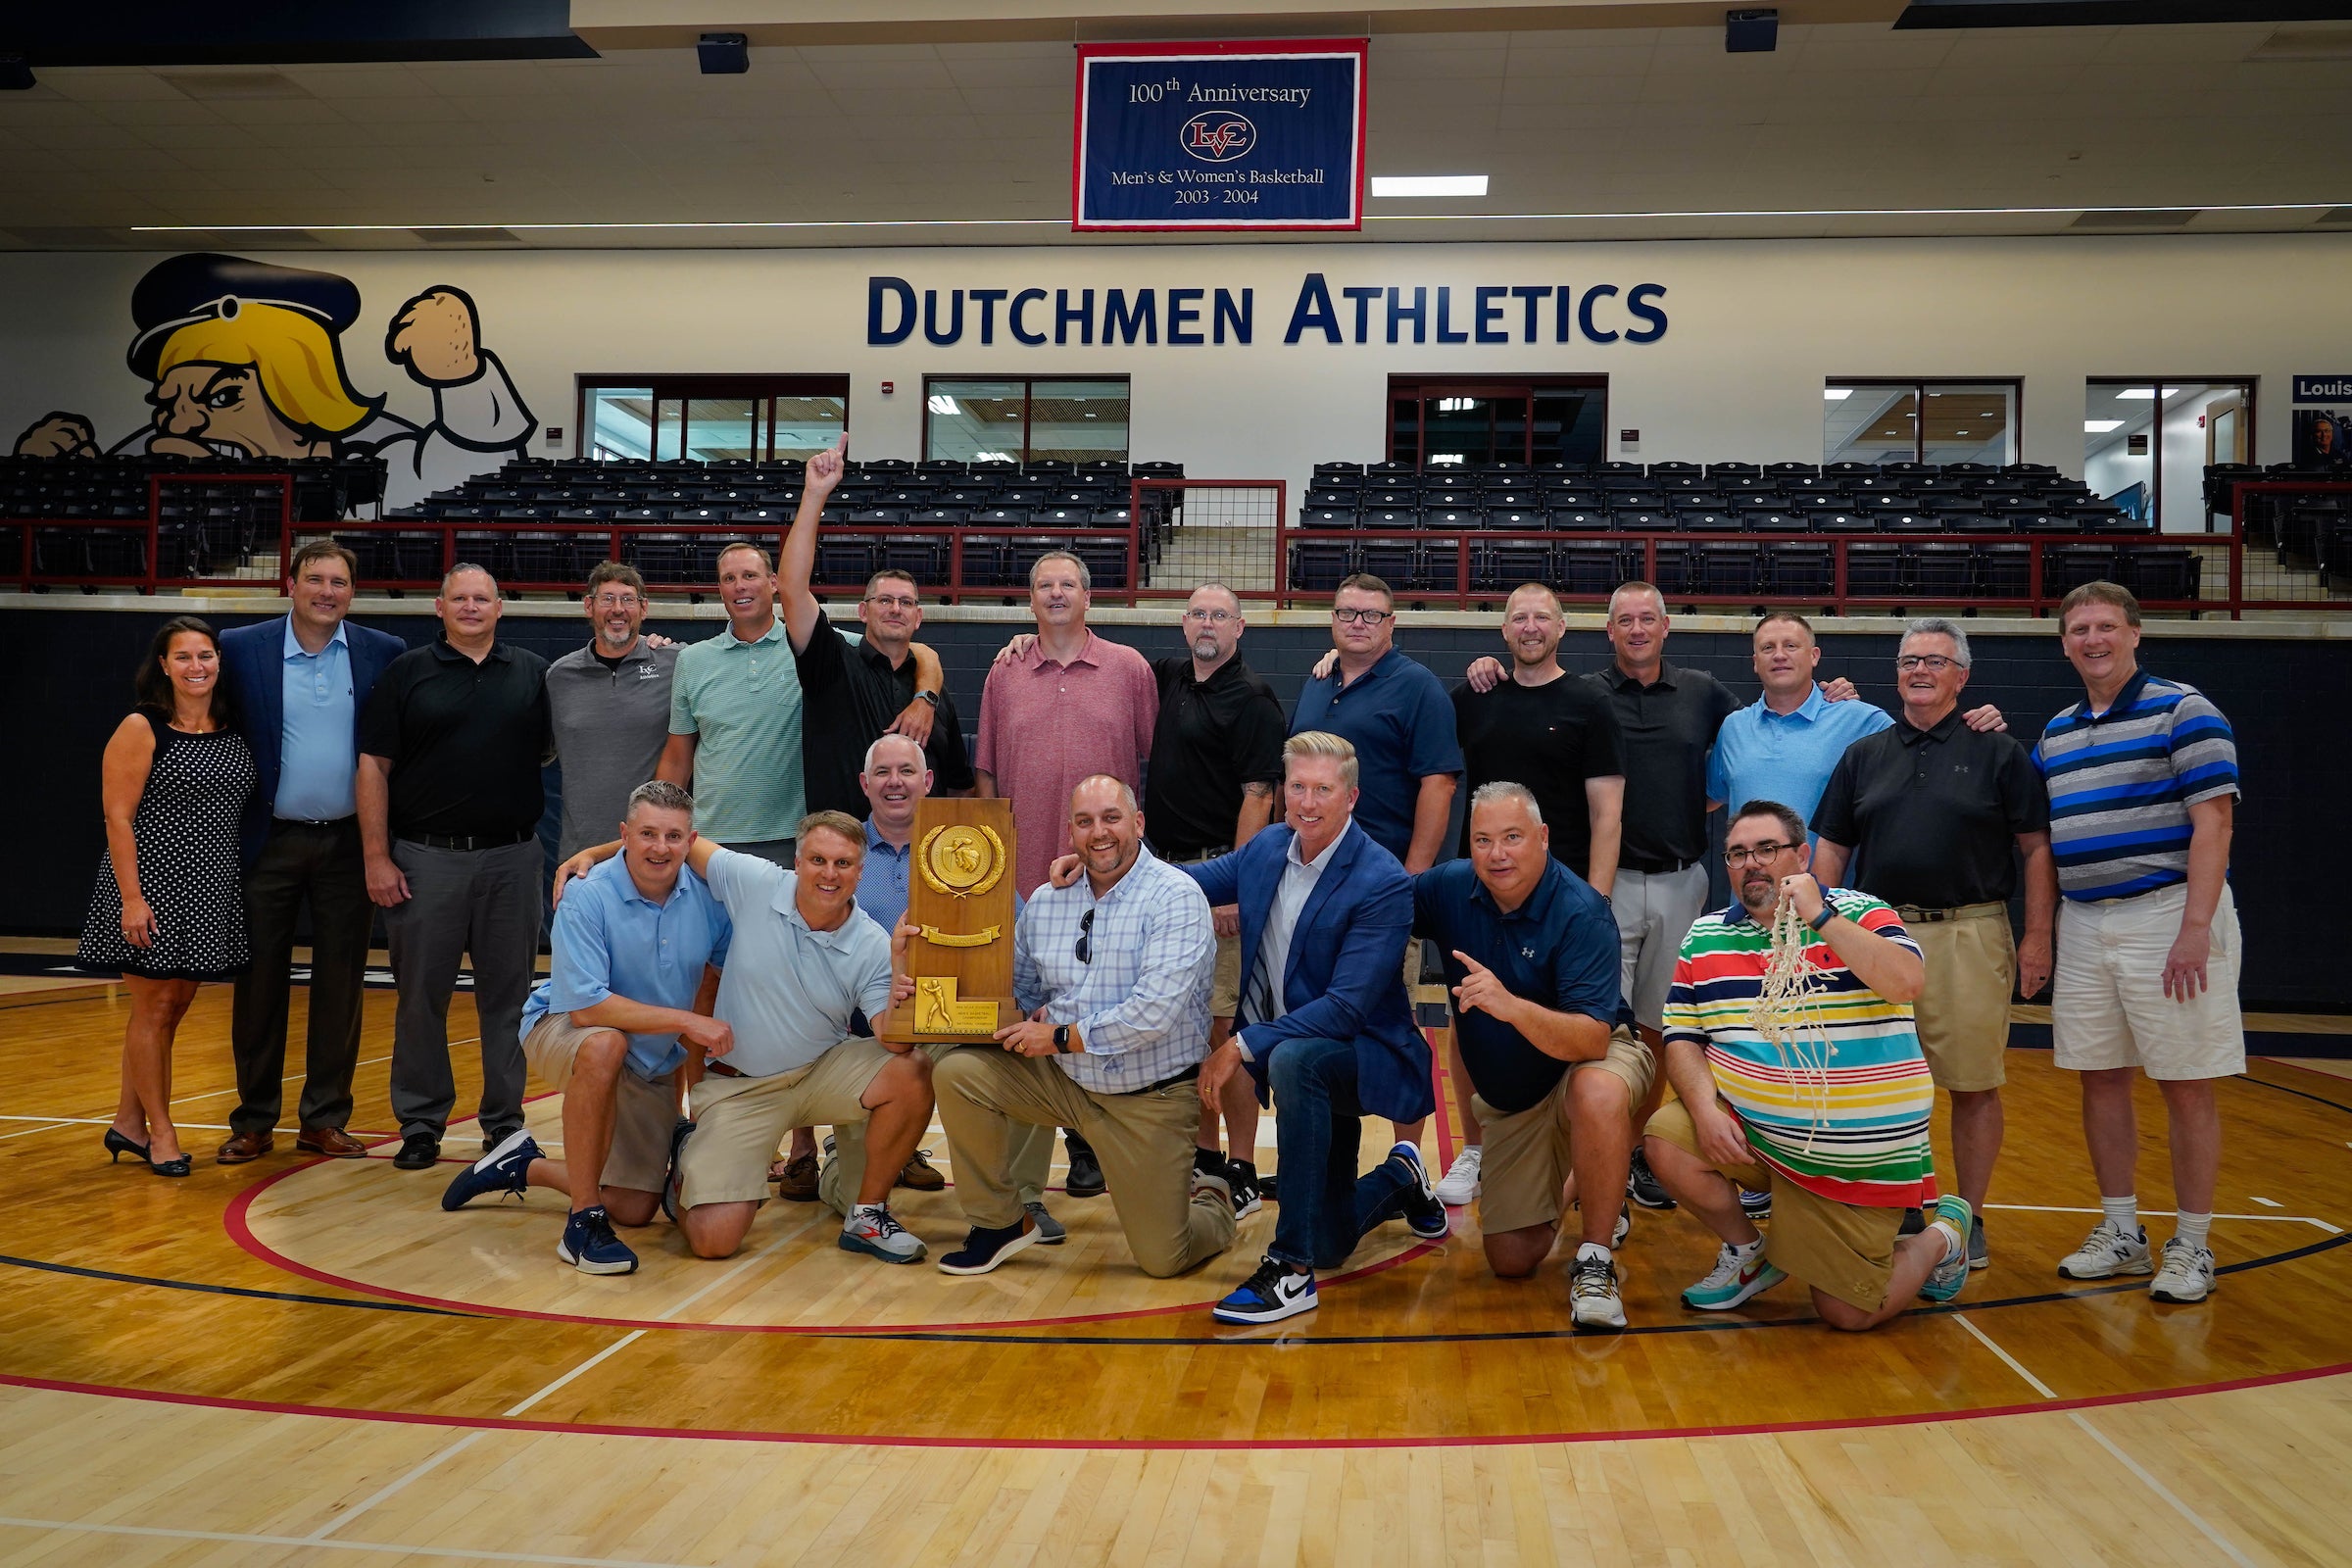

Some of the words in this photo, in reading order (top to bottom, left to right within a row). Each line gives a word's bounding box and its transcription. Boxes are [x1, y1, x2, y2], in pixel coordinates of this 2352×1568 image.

[1187, 82, 1311, 108] Anniversary
[1111, 171, 1154, 185] Men's
[1157, 171, 1174, 184] &
[1176, 169, 1247, 183] Women's
[1250, 168, 1324, 184] Basketball
[1174, 189, 1210, 205] 2003
[1223, 189, 1259, 204] 2004
[867, 276, 1253, 346] DUTCHMEN
[1284, 272, 1668, 344] ATHLETICS
